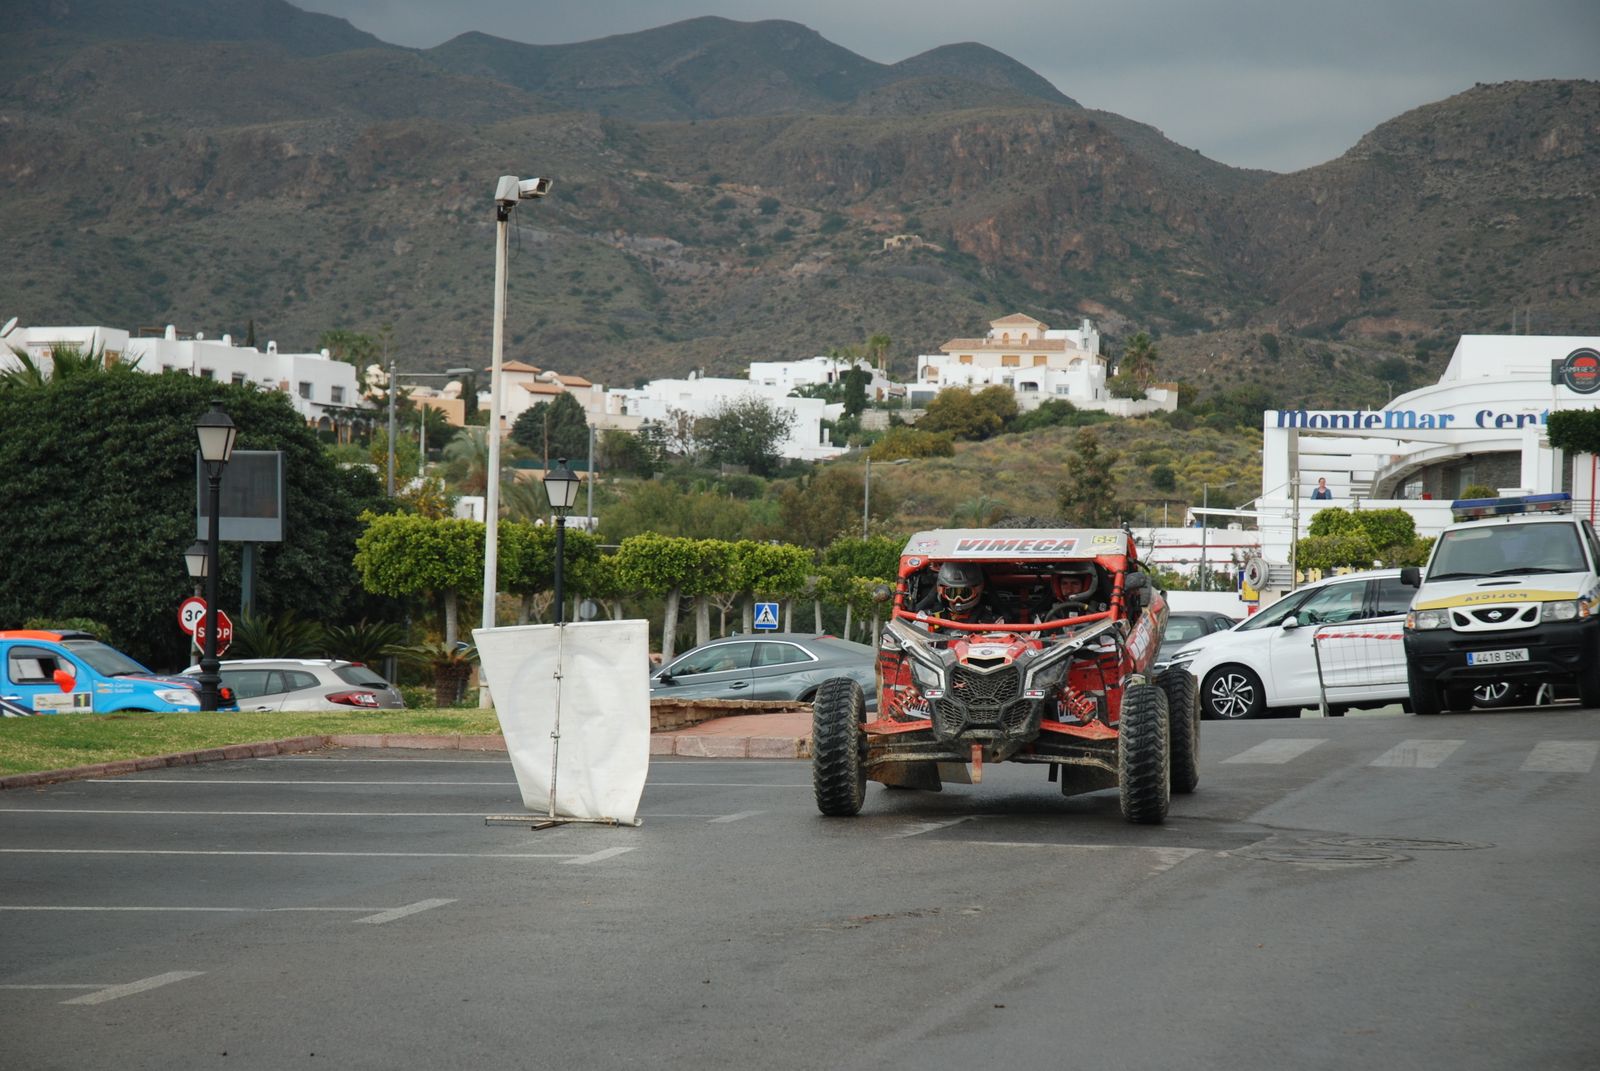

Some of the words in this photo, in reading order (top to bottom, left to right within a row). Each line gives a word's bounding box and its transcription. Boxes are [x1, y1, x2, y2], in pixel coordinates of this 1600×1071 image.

[956, 539, 1078, 552] VIMECA
[198, 626, 230, 639] SOP
[1476, 652, 1501, 663] 4418
[1504, 650, 1525, 661] BNK
[77, 693, 87, 707] 1
